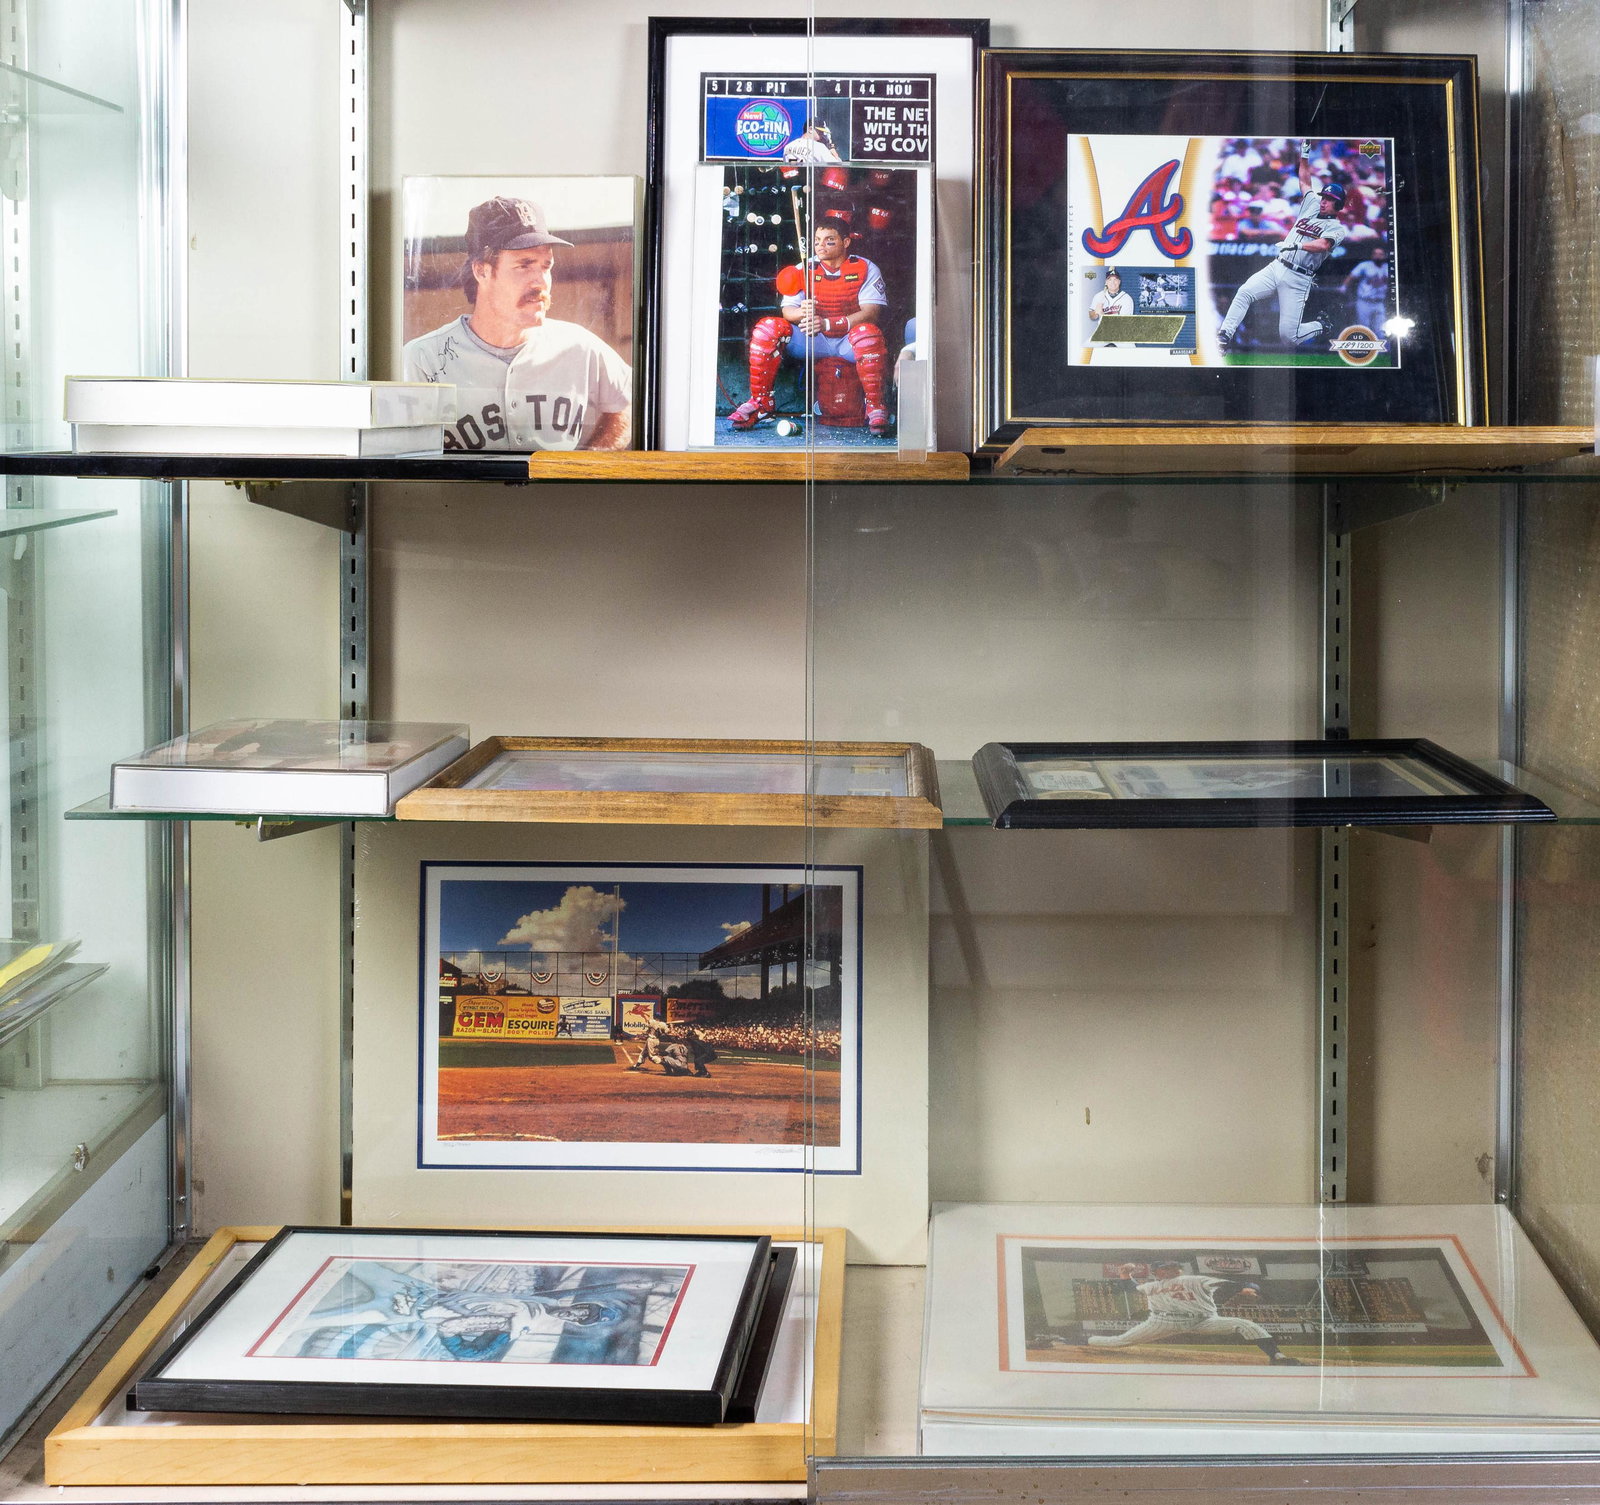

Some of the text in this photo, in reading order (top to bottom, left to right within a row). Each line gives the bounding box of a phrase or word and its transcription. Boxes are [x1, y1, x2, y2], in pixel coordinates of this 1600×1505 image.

[711, 80, 719, 92] 5
[766, 81, 787, 93] PIT
[833, 82, 842, 94] 4
[886, 84, 913, 96] HOU
[863, 106, 897, 120] THE
[736, 119, 791, 137] ECO-FINA
[863, 122, 903, 135] WITH
[863, 137, 929, 152] 3G COV
[457, 1011, 505, 1028] GEM
[507, 1020, 555, 1030] ESQUIRE
